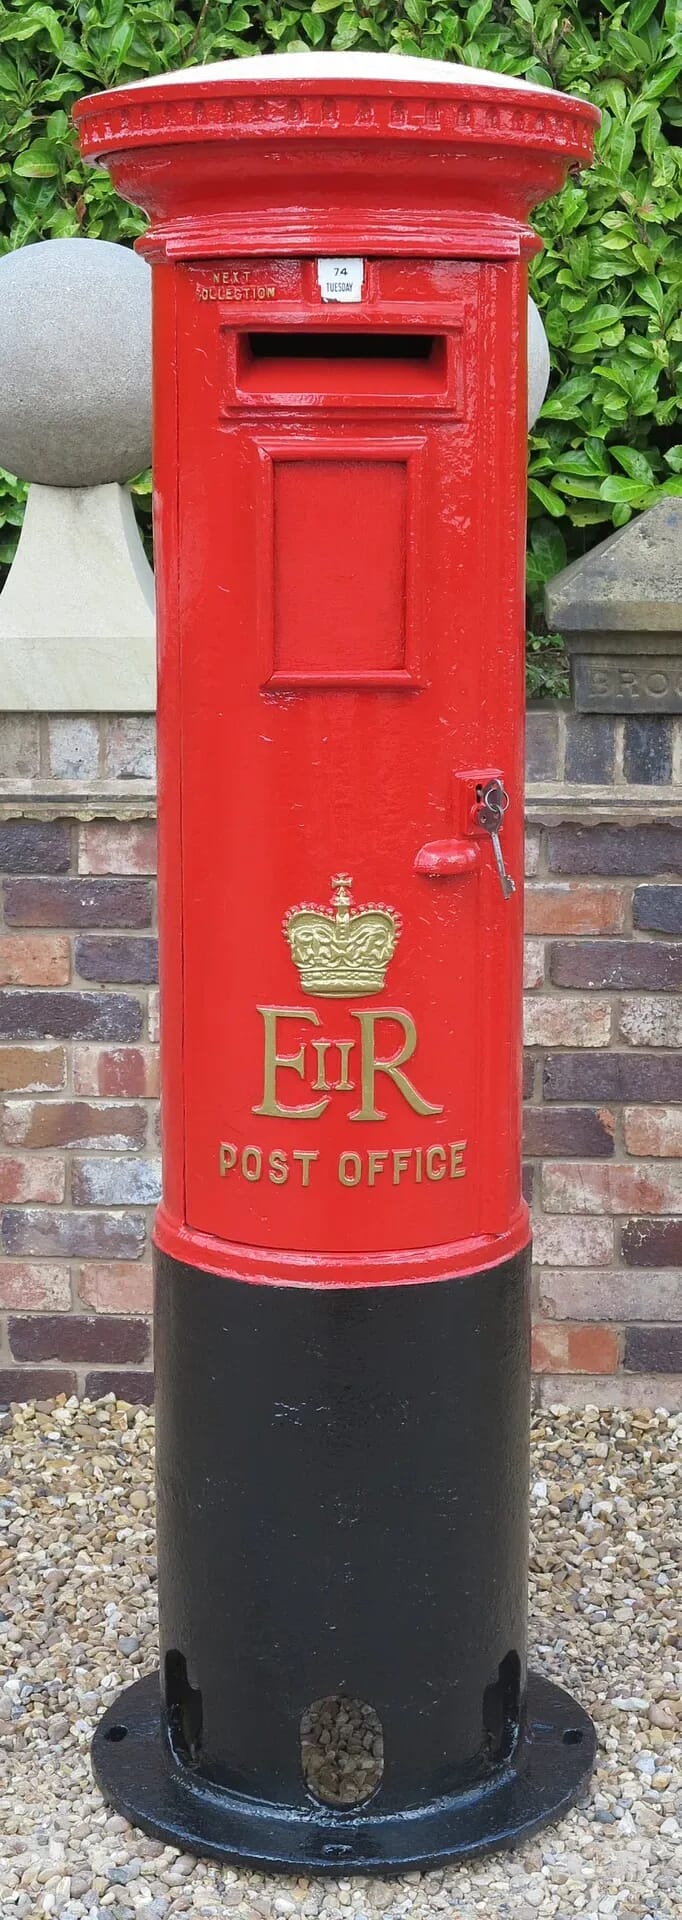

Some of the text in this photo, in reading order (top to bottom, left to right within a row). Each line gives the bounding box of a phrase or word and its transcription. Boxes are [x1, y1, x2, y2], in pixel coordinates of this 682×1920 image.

[334, 267, 348, 276] 74
[213, 271, 251, 284] NEXT
[326, 282, 353, 292] TUESDAY
[219, 1140, 467, 1187] POST OFFICE
